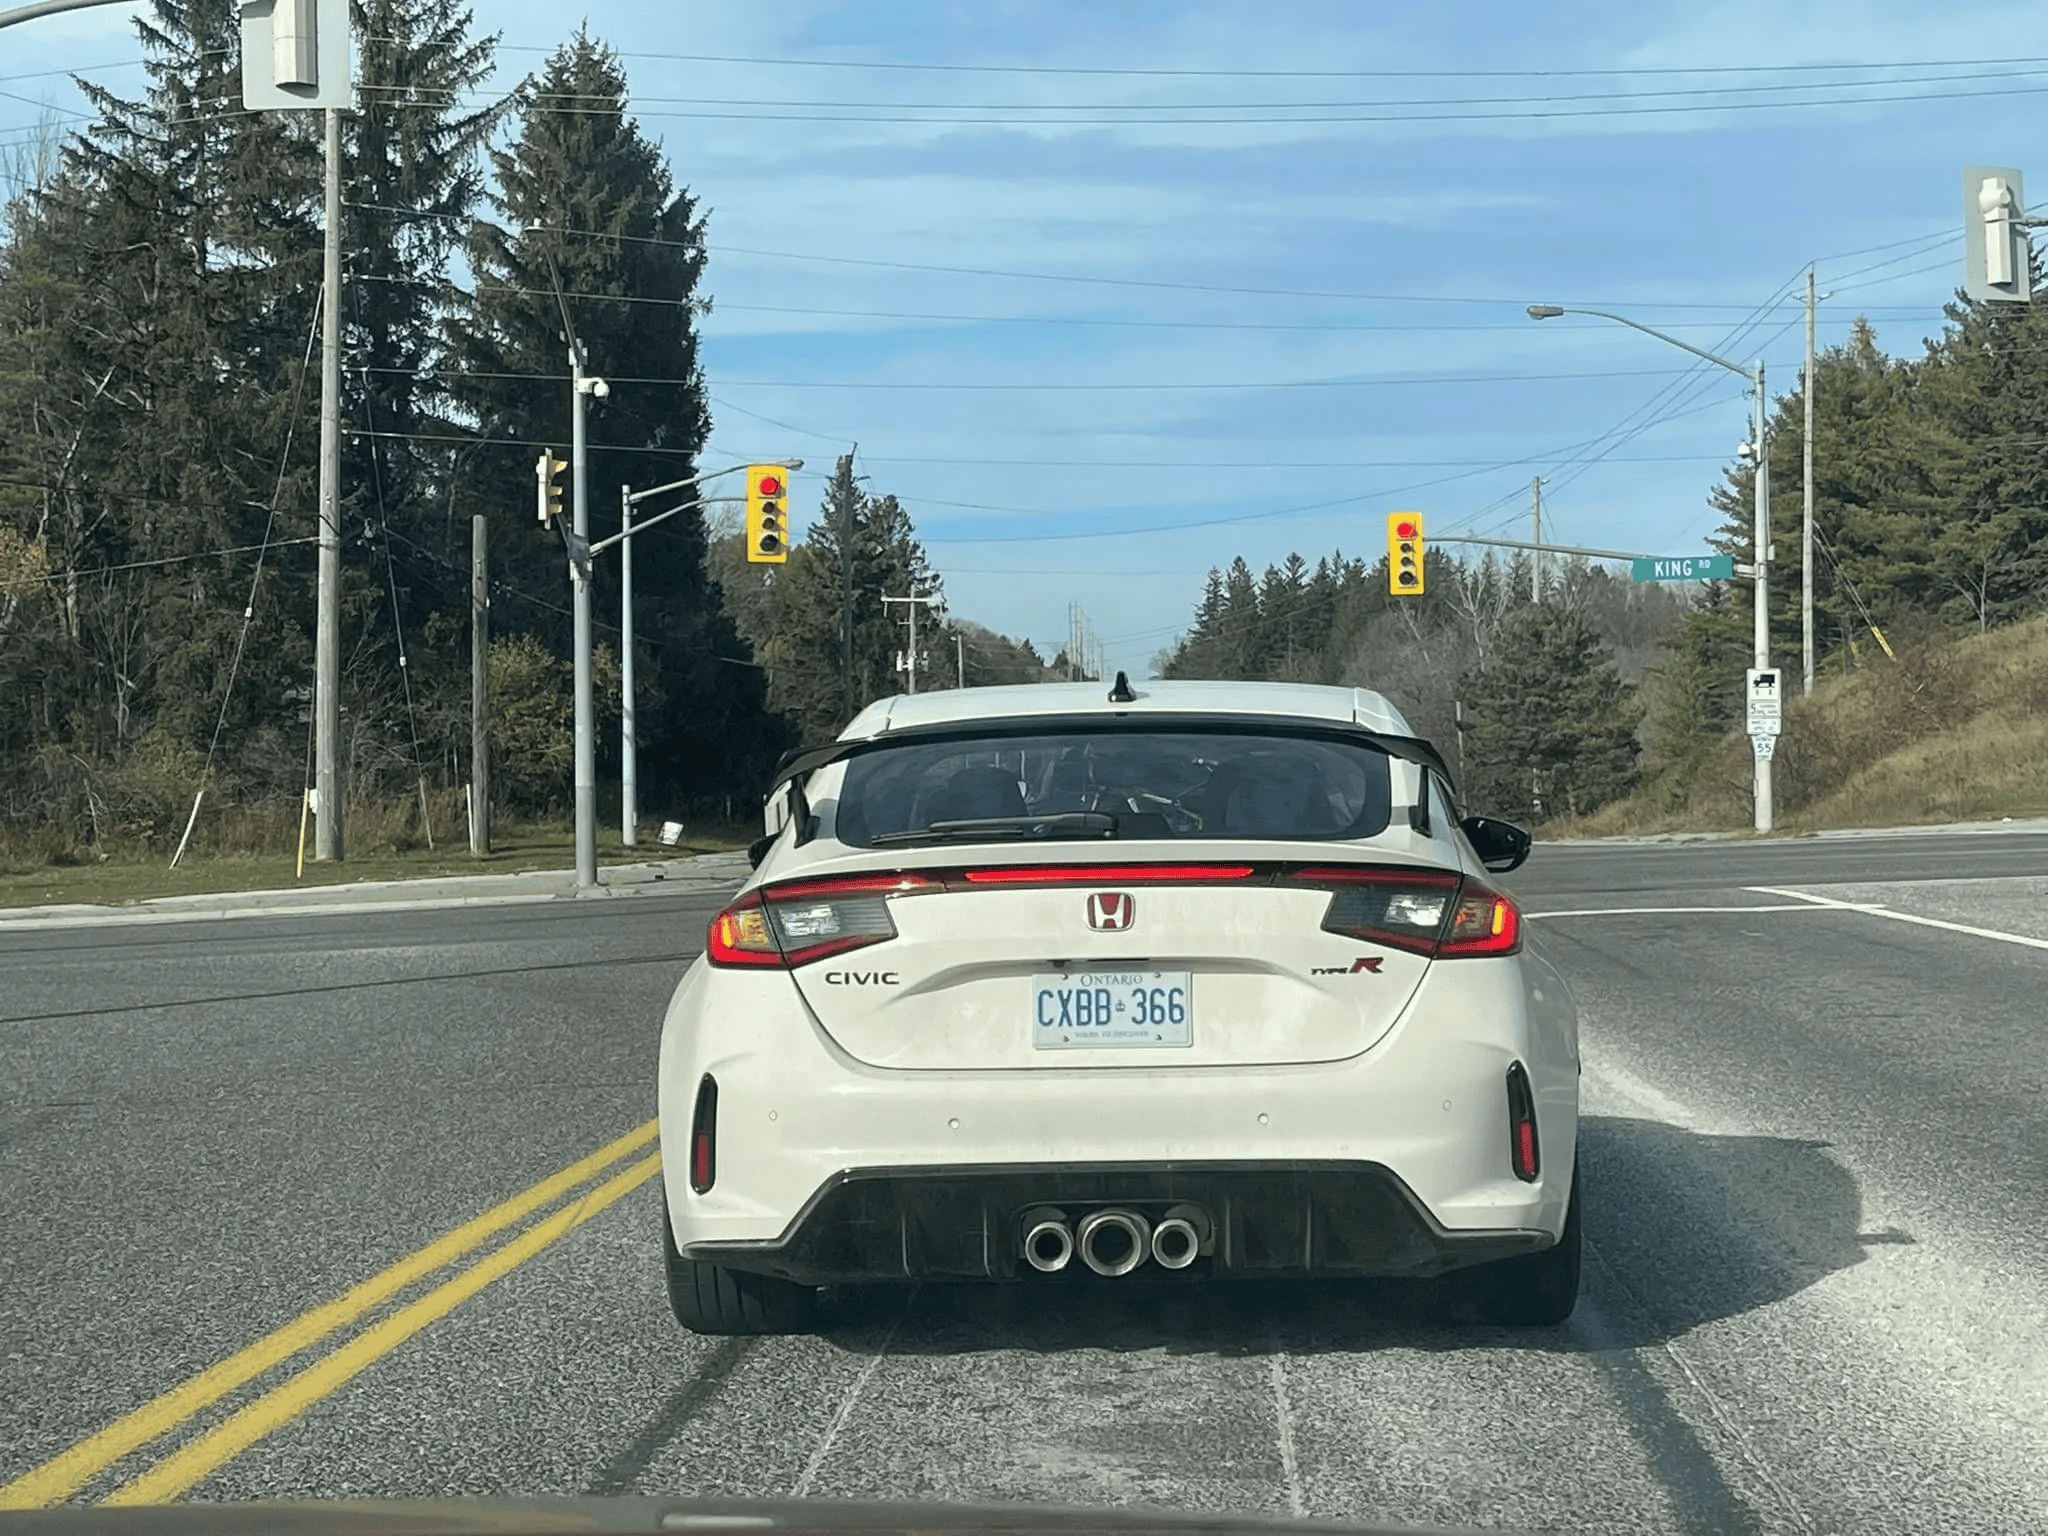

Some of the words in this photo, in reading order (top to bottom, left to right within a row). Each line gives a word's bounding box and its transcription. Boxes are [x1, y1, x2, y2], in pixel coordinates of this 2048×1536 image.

[1654, 561, 1693, 577] KING
[1699, 560, 1711, 569] RD
[1757, 742, 1772, 753] 55
[825, 972, 899, 985] CIVIC
[1080, 974, 1144, 987] ONTARIO
[1037, 988, 1112, 1028] CXBB
[1131, 987, 1185, 1026] 366
